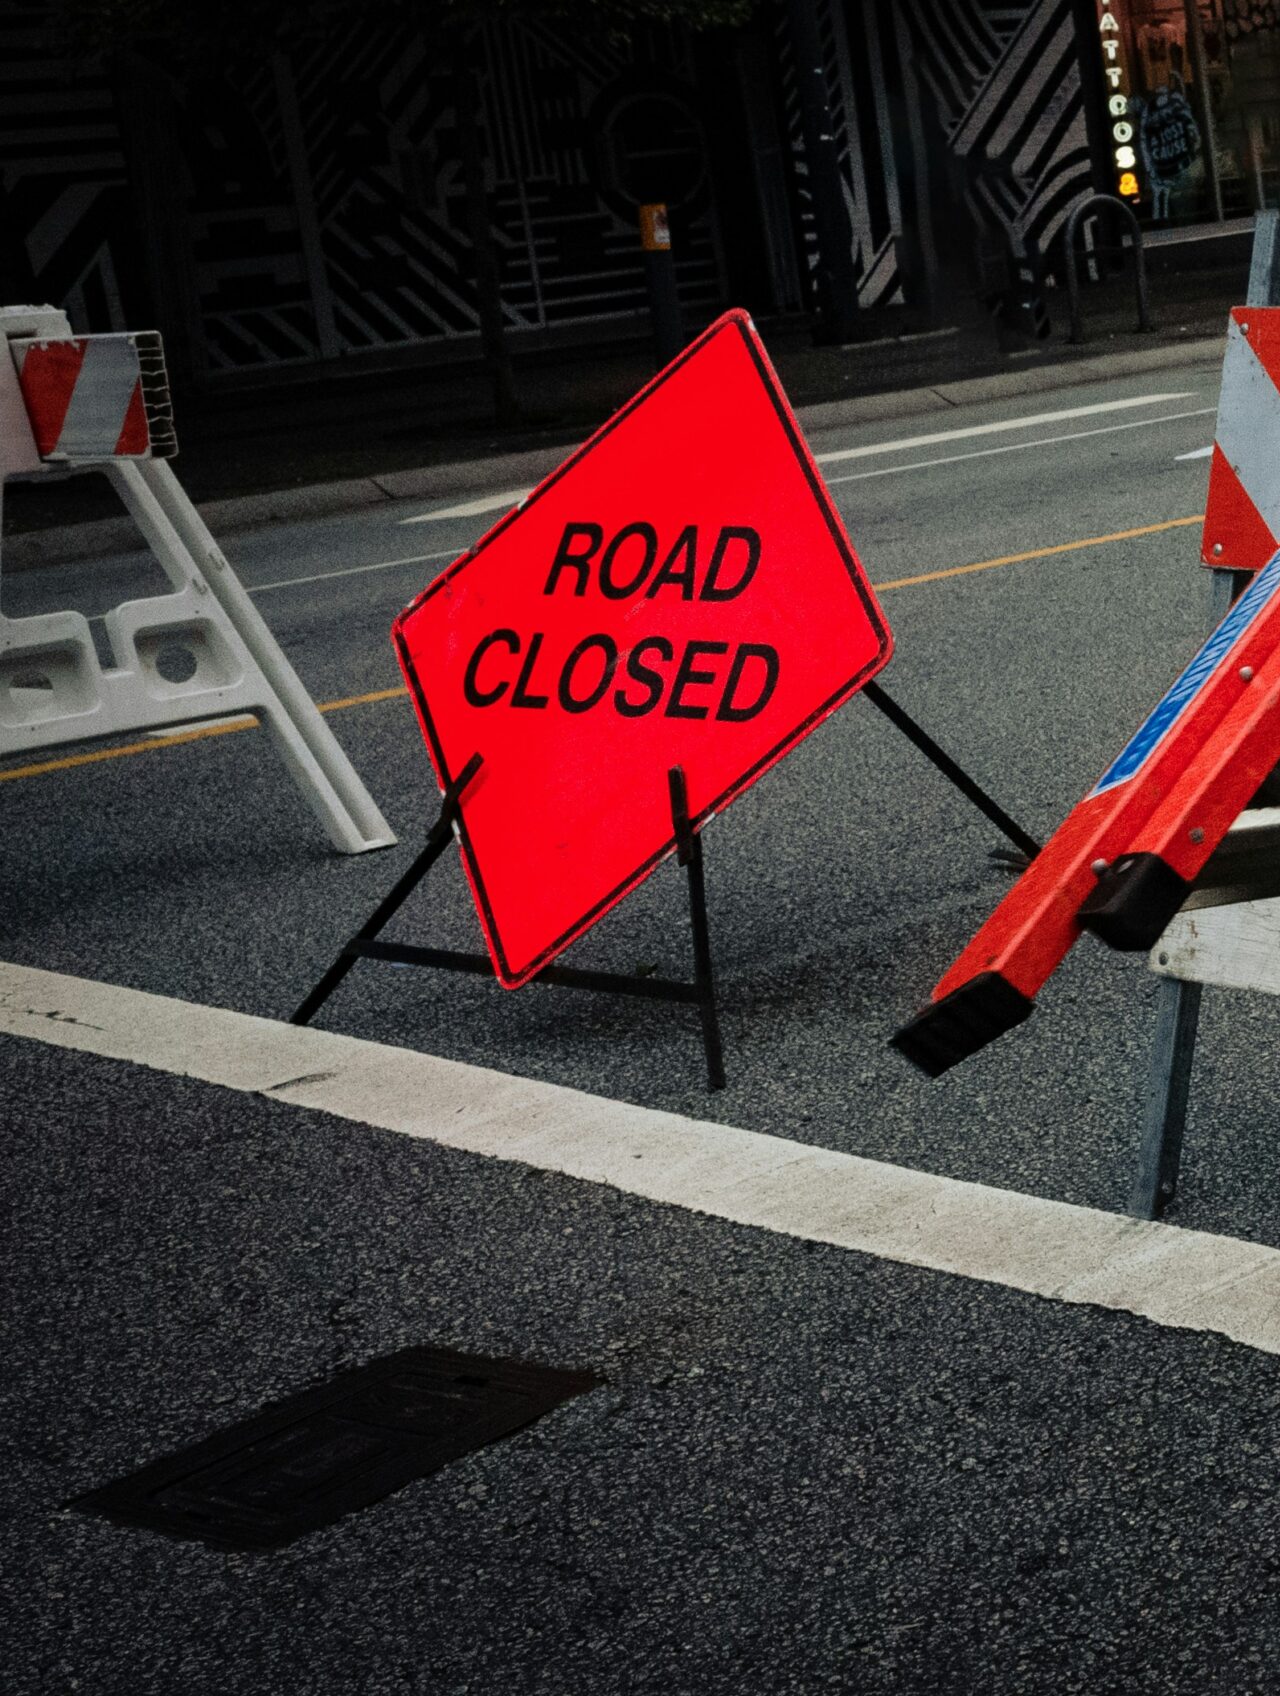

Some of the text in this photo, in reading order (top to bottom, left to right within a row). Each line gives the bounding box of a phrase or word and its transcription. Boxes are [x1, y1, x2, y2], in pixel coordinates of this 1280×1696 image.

[1099, 0, 1139, 196] ATTOOS &
[1152, 138, 1188, 160] CAUSE
[544, 522, 761, 602] ROAD
[463, 628, 780, 723] CLOSED
